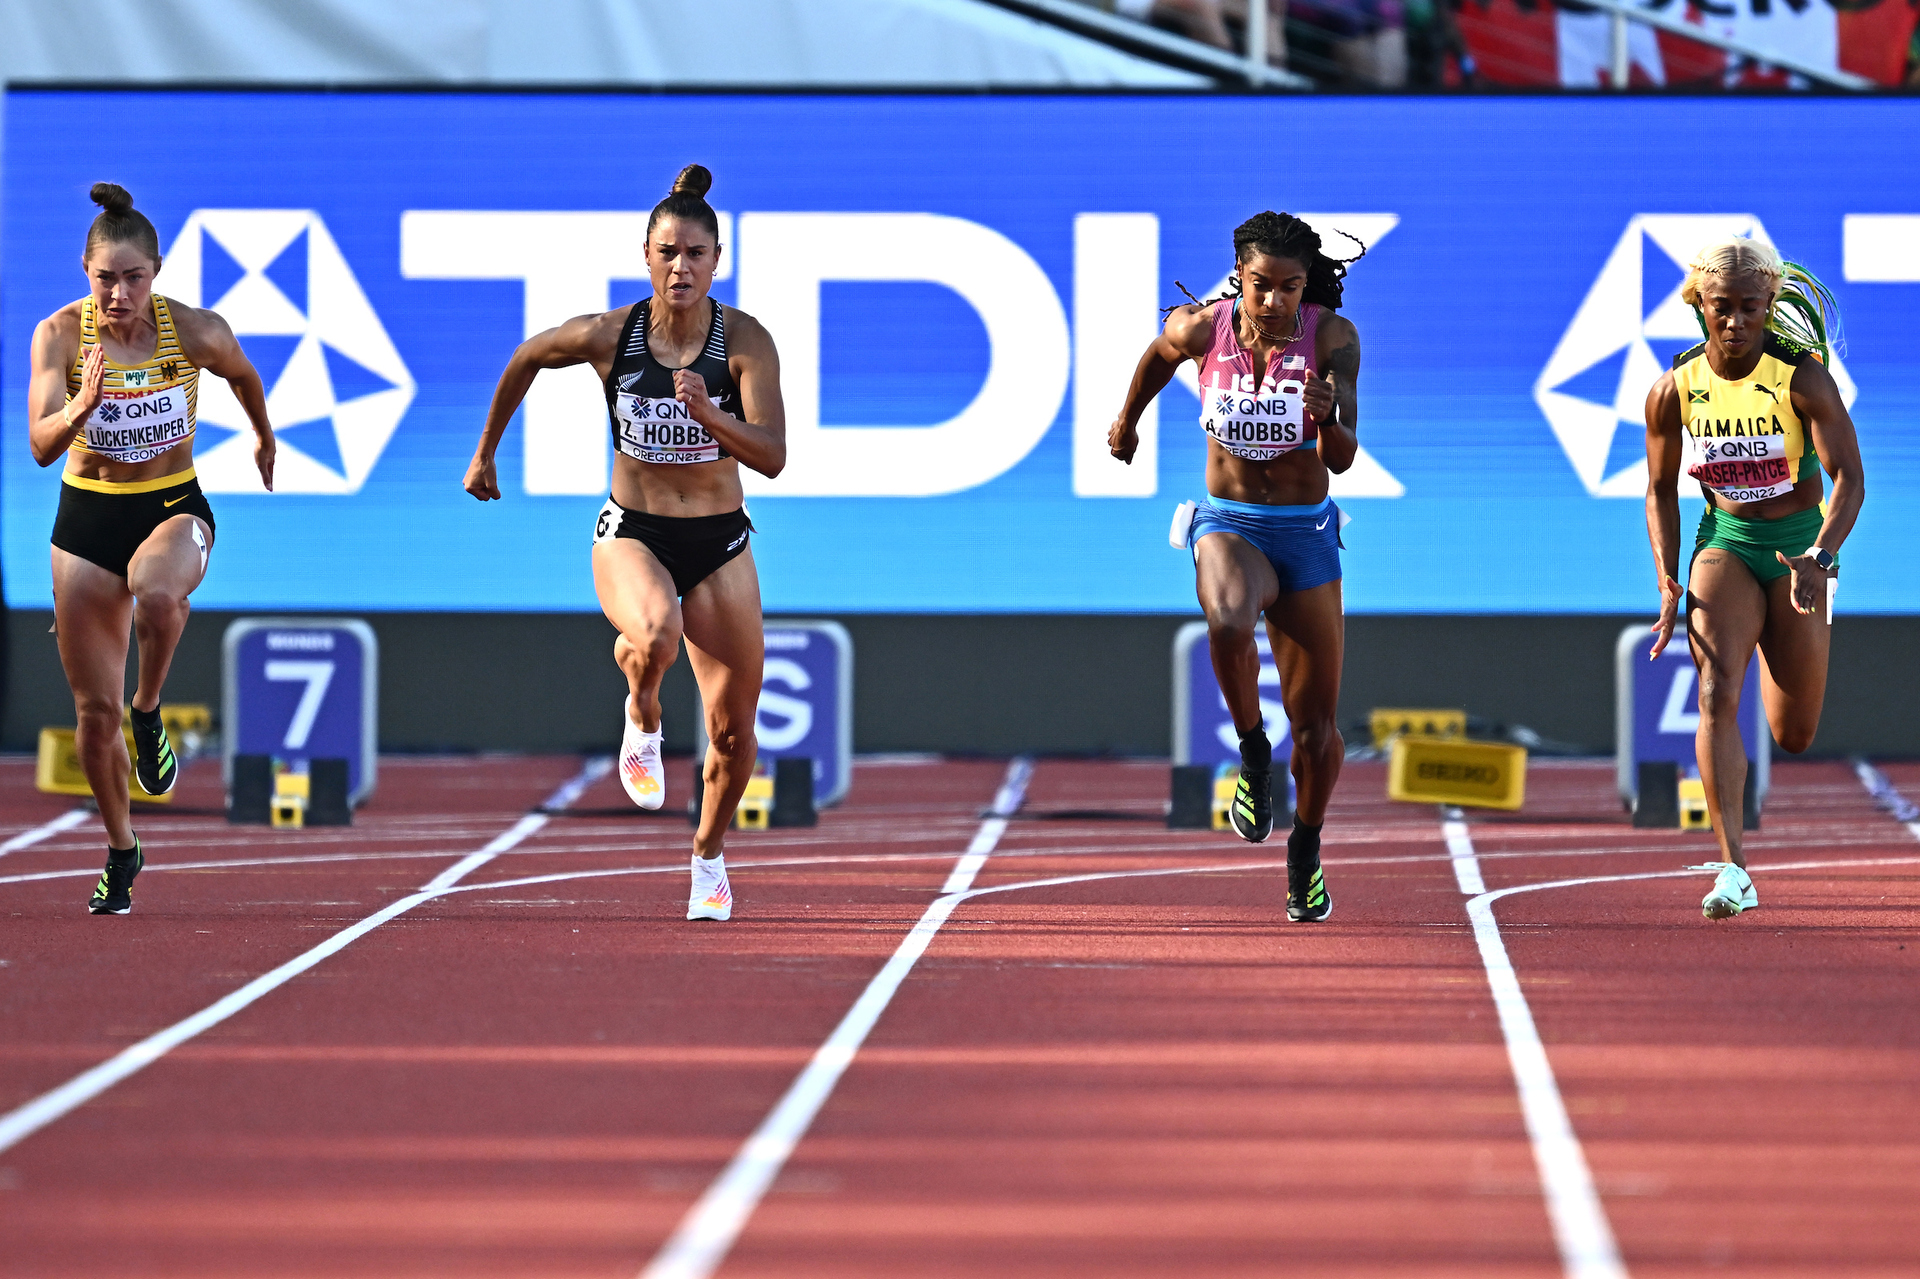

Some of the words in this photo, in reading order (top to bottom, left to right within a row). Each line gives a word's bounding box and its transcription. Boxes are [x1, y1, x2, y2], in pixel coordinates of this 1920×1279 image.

[401, 211, 1403, 497] TDK
[126, 396, 172, 419] QNB
[656, 403, 693, 420] QN
[1239, 398, 1287, 416] QNB
[89, 417, 186, 448] LÜCKENKEMPER
[623, 419, 637, 440] Z.
[644, 424, 714, 446] HOBBS
[1228, 420, 1297, 442] HOBBS
[1695, 414, 1785, 438] JAMAICA
[633, 447, 702, 463] OREGON22
[1721, 441, 1769, 458] QNB
[1722, 487, 1777, 500] EGON22
[264, 661, 335, 749] 7
